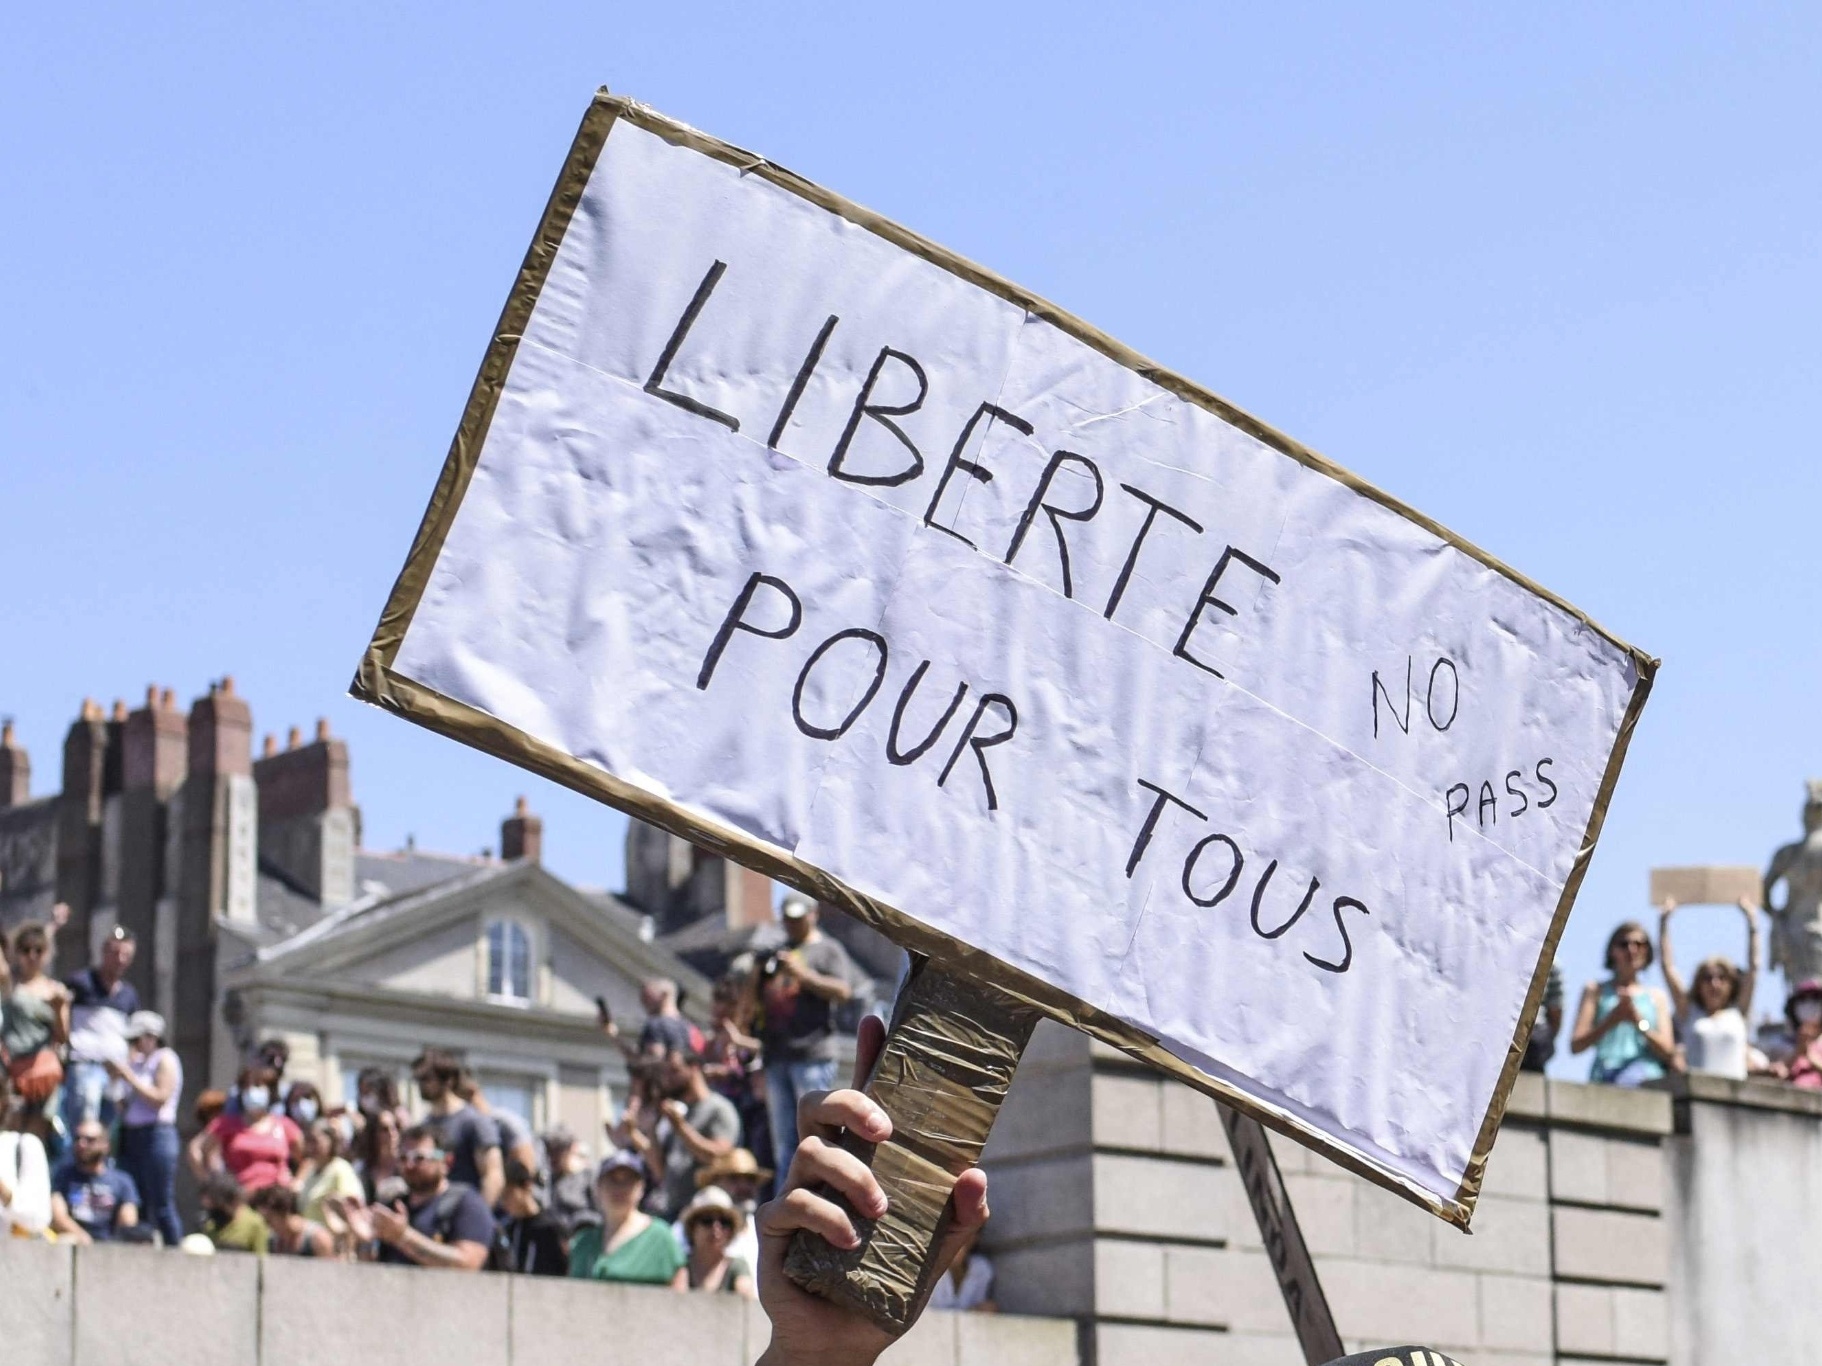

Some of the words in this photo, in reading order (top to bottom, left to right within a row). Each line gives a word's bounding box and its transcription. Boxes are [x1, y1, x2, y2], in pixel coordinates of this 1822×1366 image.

[643, 259, 1281, 679] LIBERTE
[696, 571, 1019, 811] POUR
[1125, 778, 1370, 973] TOUS
[1371, 654, 1459, 739] NO
[1446, 756, 1558, 842] PASS
